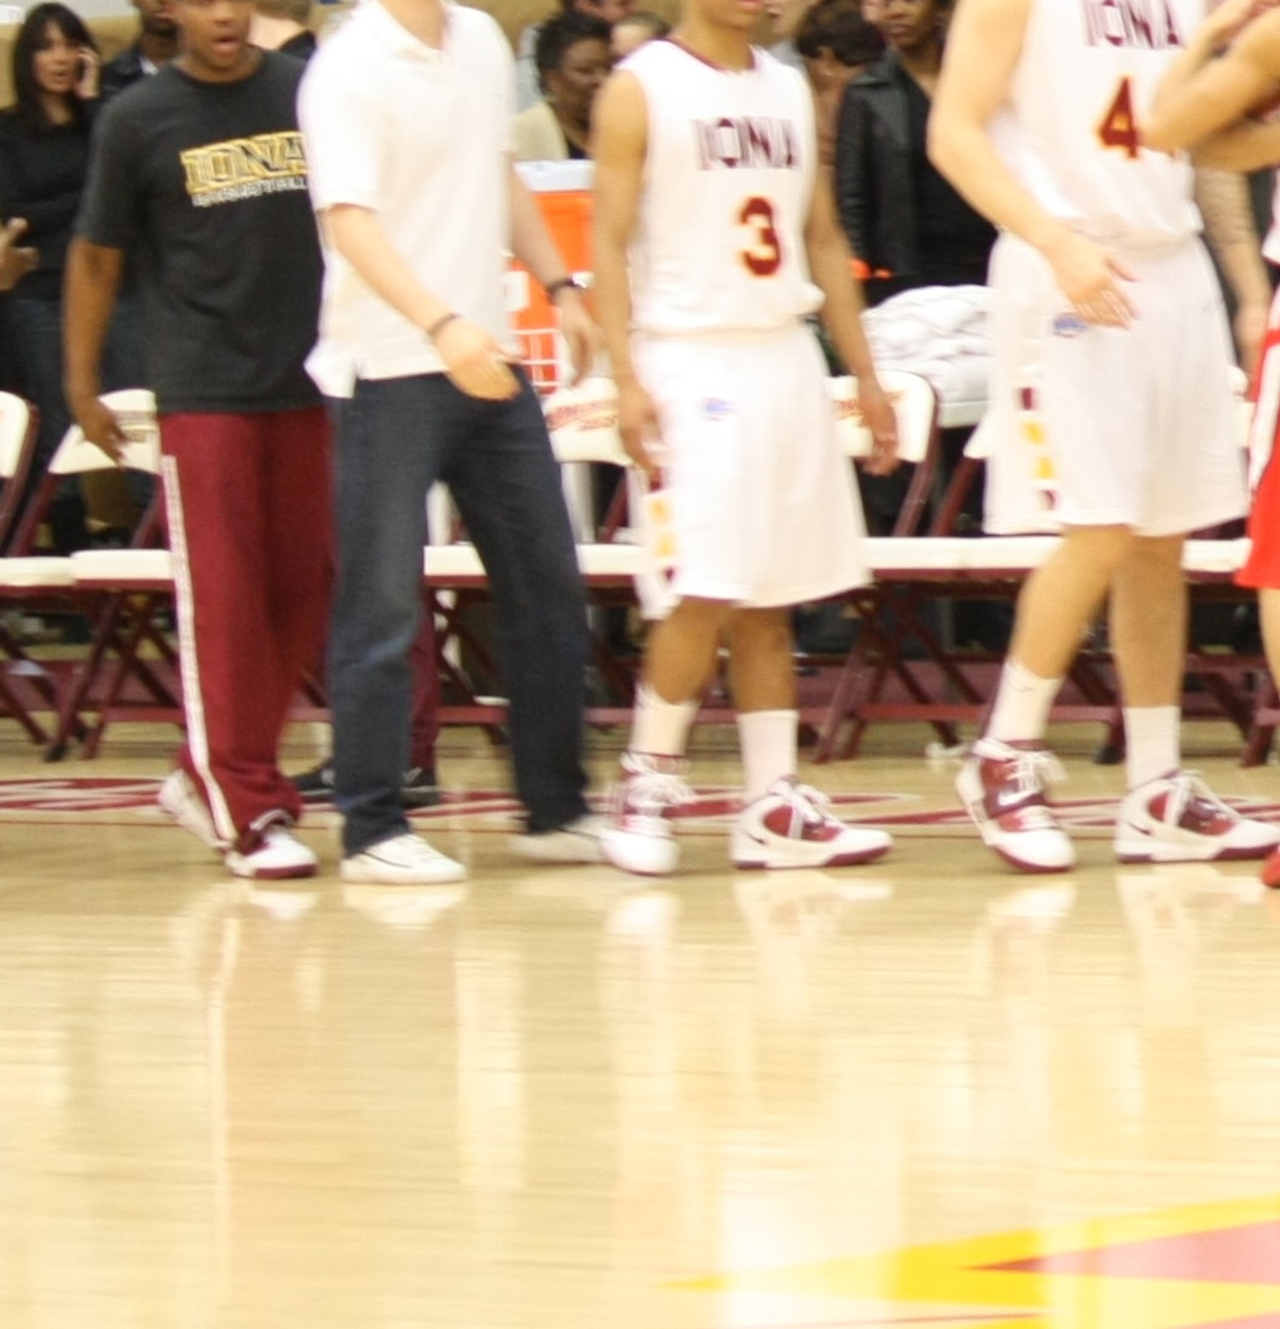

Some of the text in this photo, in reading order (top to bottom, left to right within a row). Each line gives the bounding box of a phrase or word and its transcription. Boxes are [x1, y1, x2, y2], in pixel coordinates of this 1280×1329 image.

[179, 130, 307, 195] IONA
[691, 116, 803, 171] IONA
[735, 193, 784, 279] 3
